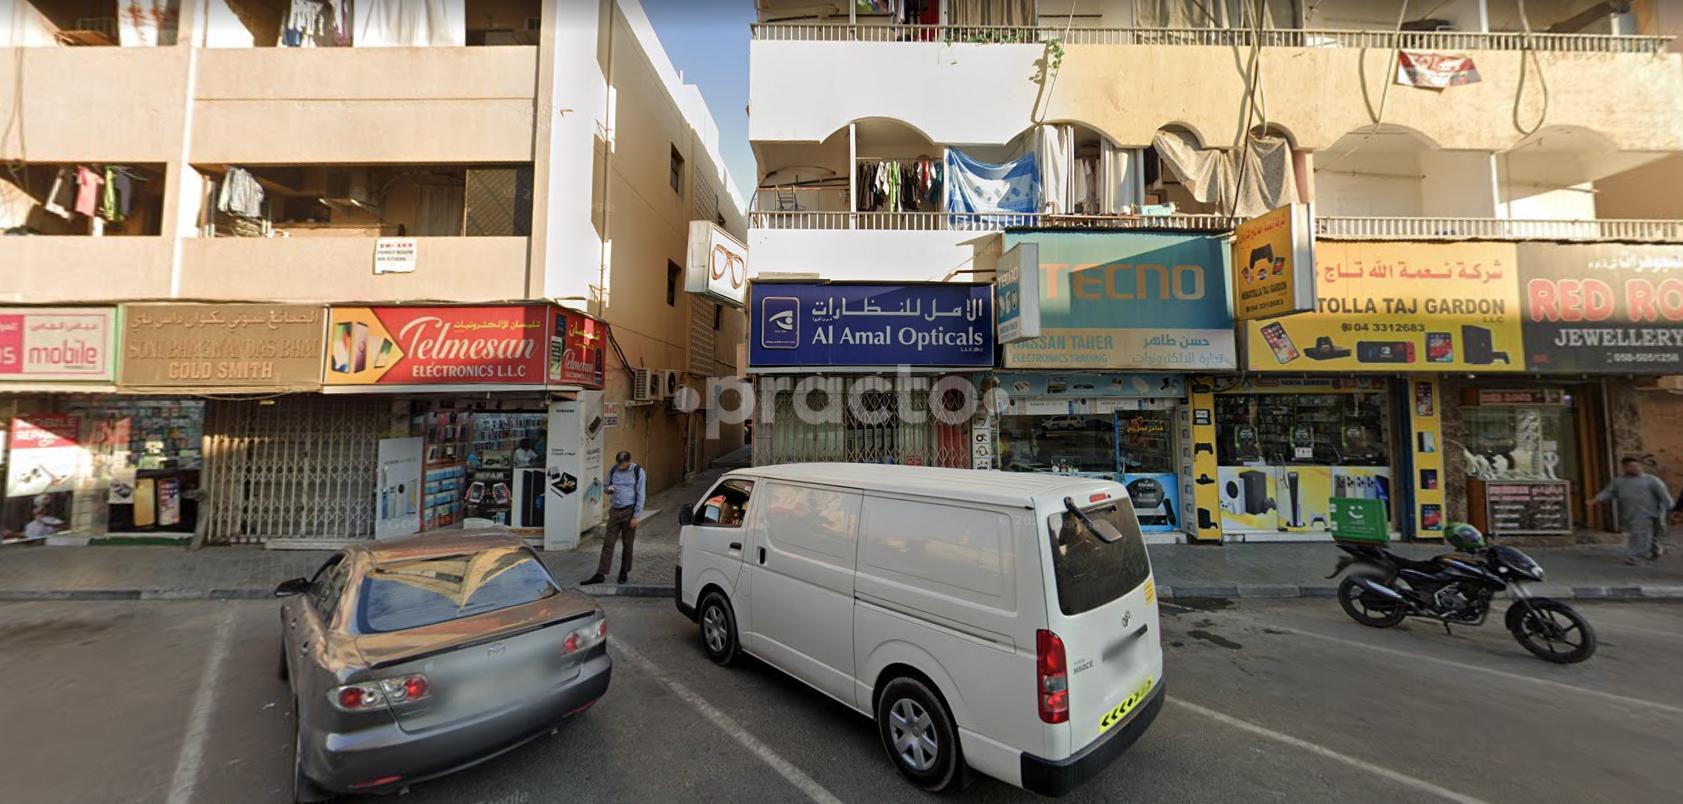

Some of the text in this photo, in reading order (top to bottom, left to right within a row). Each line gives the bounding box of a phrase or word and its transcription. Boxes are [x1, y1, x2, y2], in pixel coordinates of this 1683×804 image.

[1398, 261, 1452, 279] نعمة
[1458, 260, 1503, 283] شركة
[811, 297, 921, 320] للنظارات
[1383, 298, 1418, 315] TAJ
[1425, 298, 1505, 315] GARDON
[1528, 278, 1615, 322] RED
[1355, 324, 1425, 332] 04 3312683
[1554, 328, 1683, 347] JEWELLERY
[399, 315, 540, 361] Telmesan
[812, 325, 833, 345] Al
[840, 325, 891, 345] Amal
[898, 326, 983, 351] Opticals
[1072, 335, 1113, 350] TAHER
[29, 339, 97, 364] mobile
[1012, 353, 1068, 363] ELECTRONICS
[168, 361, 273, 380] GOLD SMITH
[412, 364, 526, 378] ELECTRONICS L.L.C
